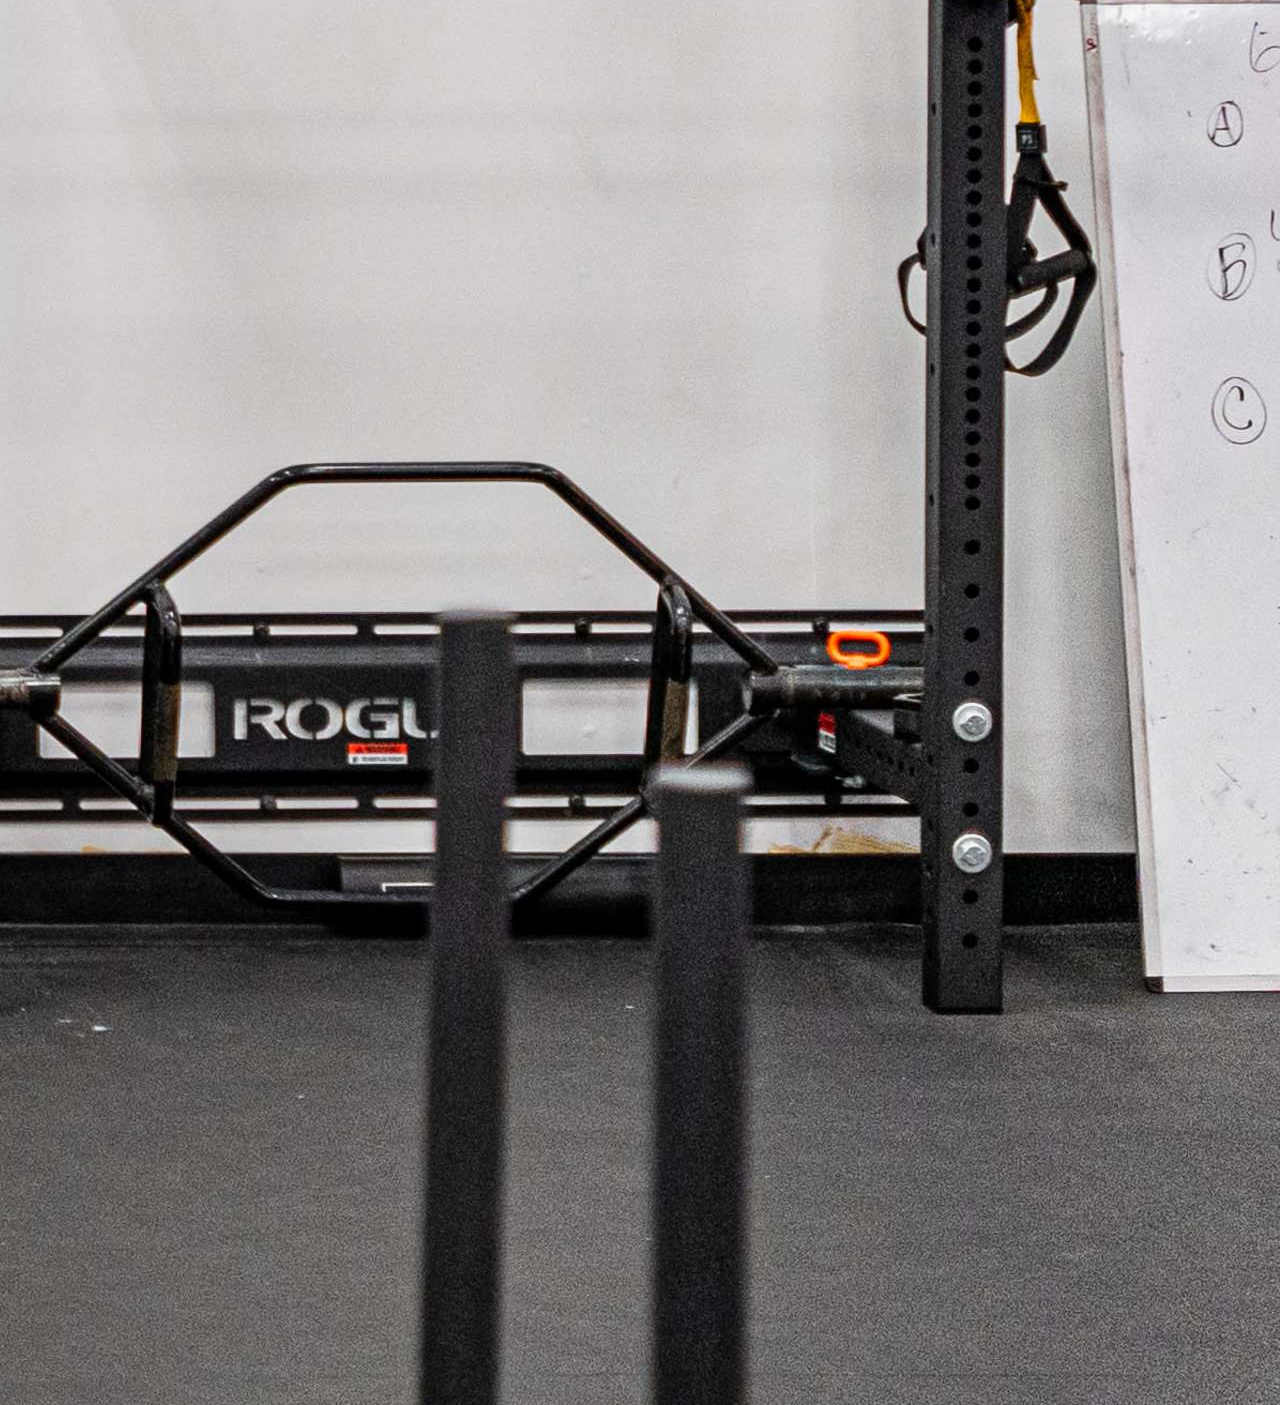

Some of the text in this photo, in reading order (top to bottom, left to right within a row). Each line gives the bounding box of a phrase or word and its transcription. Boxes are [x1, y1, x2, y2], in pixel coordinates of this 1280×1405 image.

[1209, 104, 1237, 144] A
[1216, 239, 1250, 300] B
[1218, 382, 1257, 434] C
[234, 698, 439, 740] ROGU
